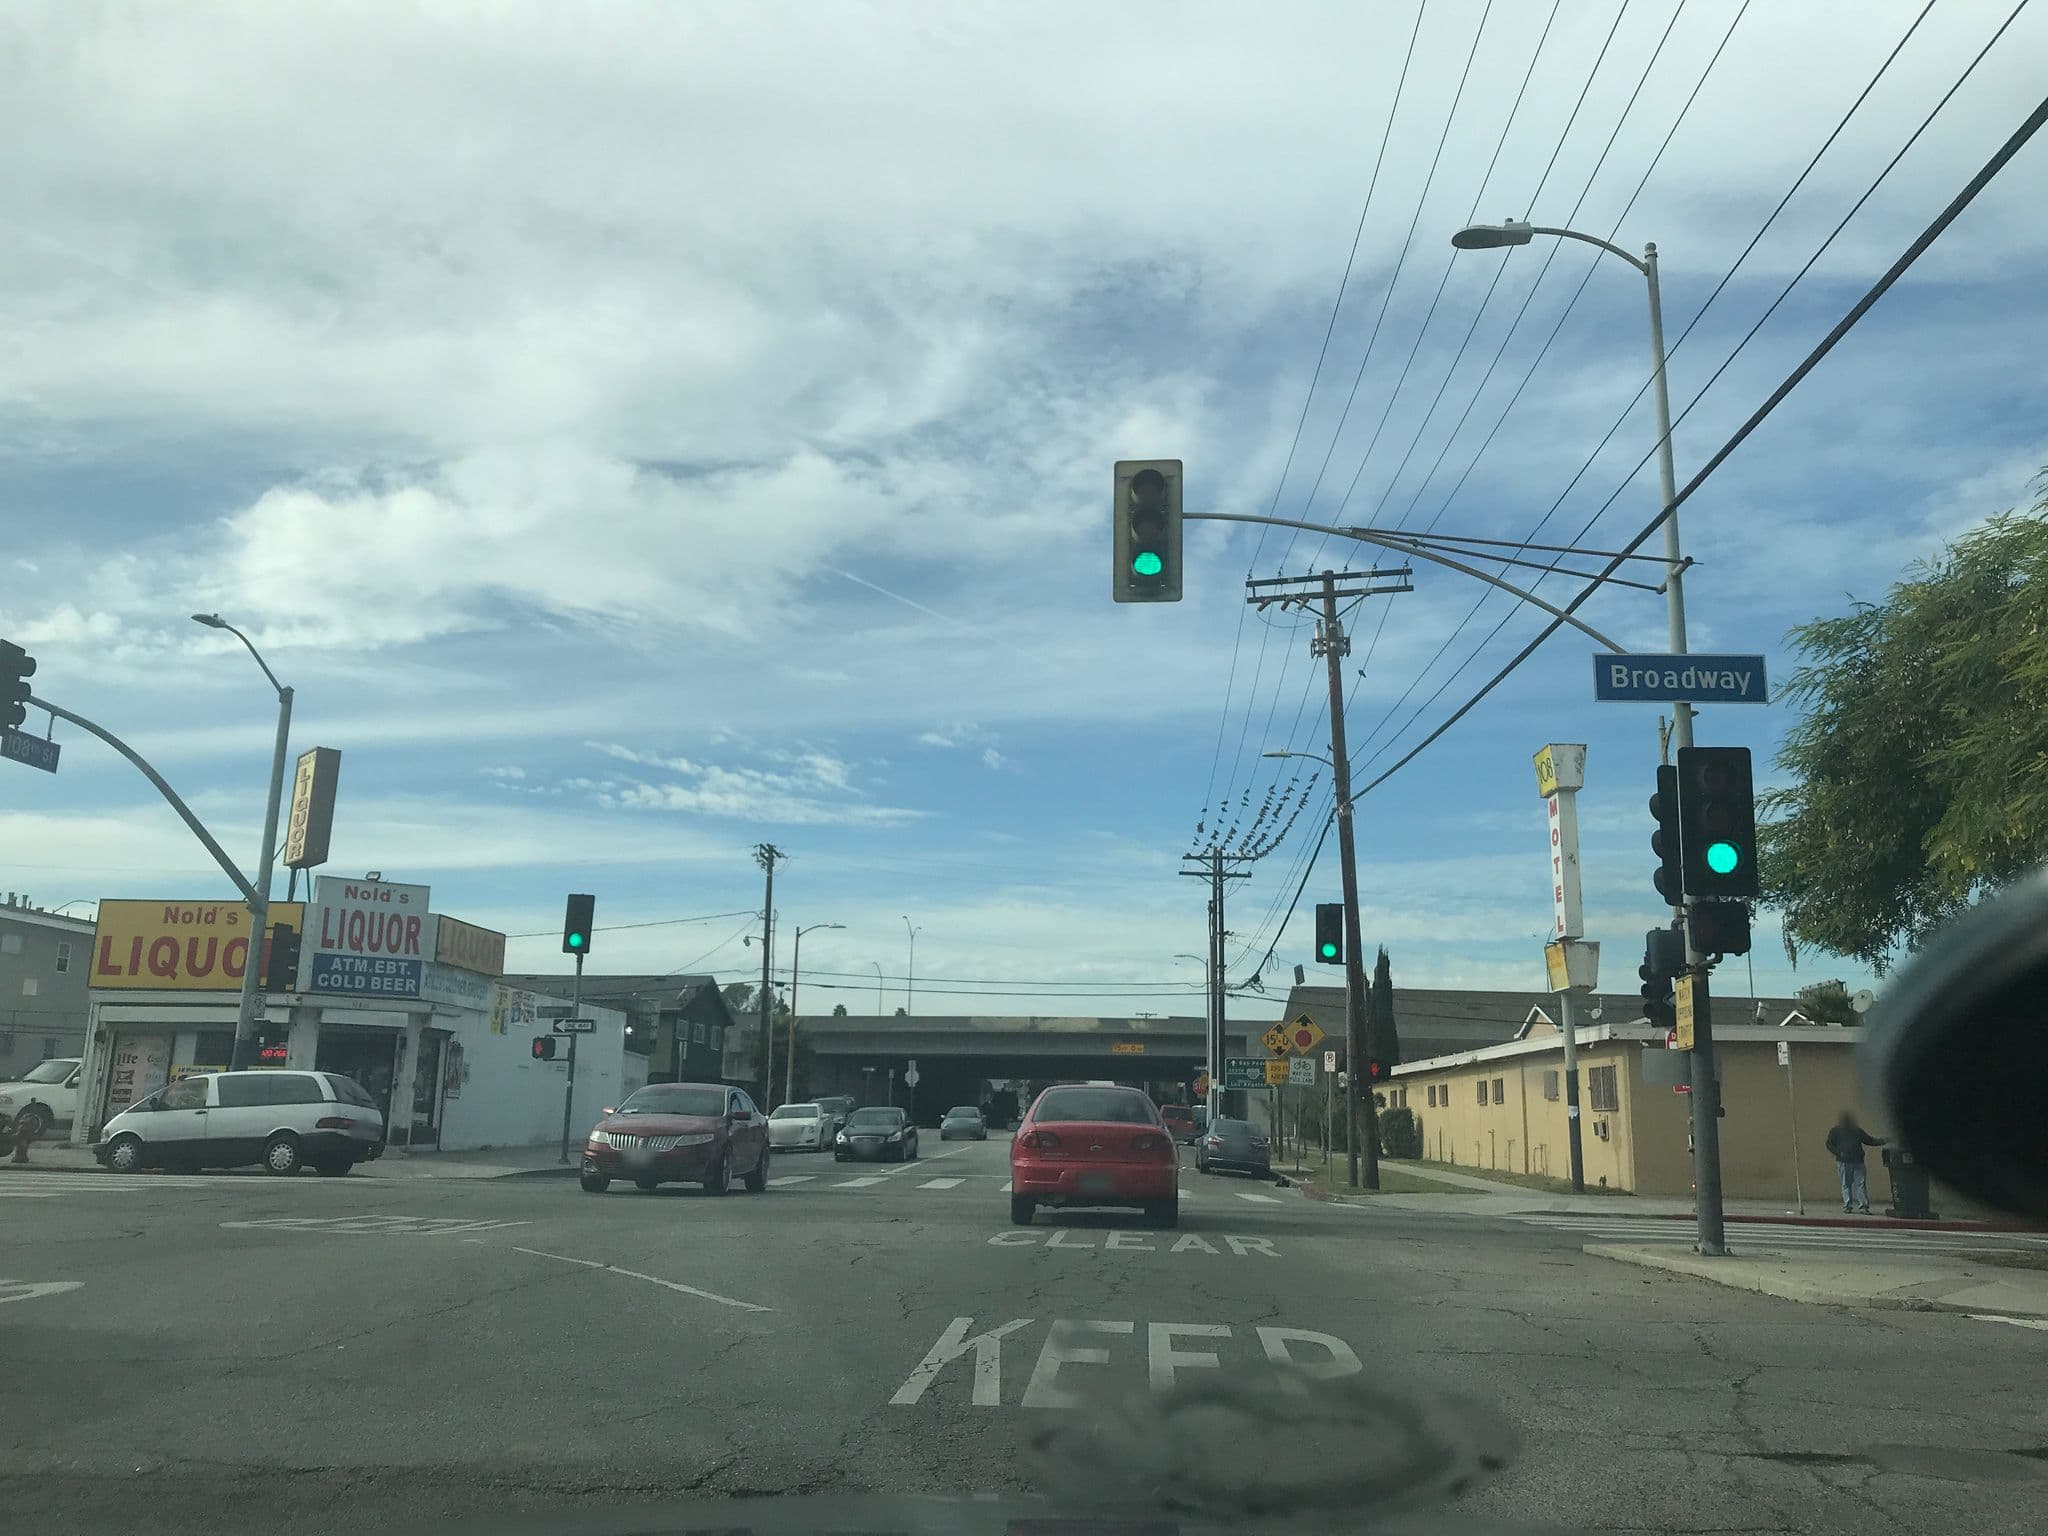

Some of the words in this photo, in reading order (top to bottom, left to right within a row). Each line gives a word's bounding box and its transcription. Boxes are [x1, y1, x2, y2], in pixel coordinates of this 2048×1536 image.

[1610, 664, 1752, 696] Broadway
[1537, 756, 1554, 785] 108
[288, 767, 312, 860] LIQUOR
[1548, 798, 1564, 934] MOTEL
[344, 885, 410, 904] Nold's
[162, 906, 239, 925] Nold's
[321, 906, 421, 955] LIQUOR
[317, 973, 366, 990] COLD
[370, 976, 417, 993] BEER
[986, 1229, 1282, 1257] CLEAR
